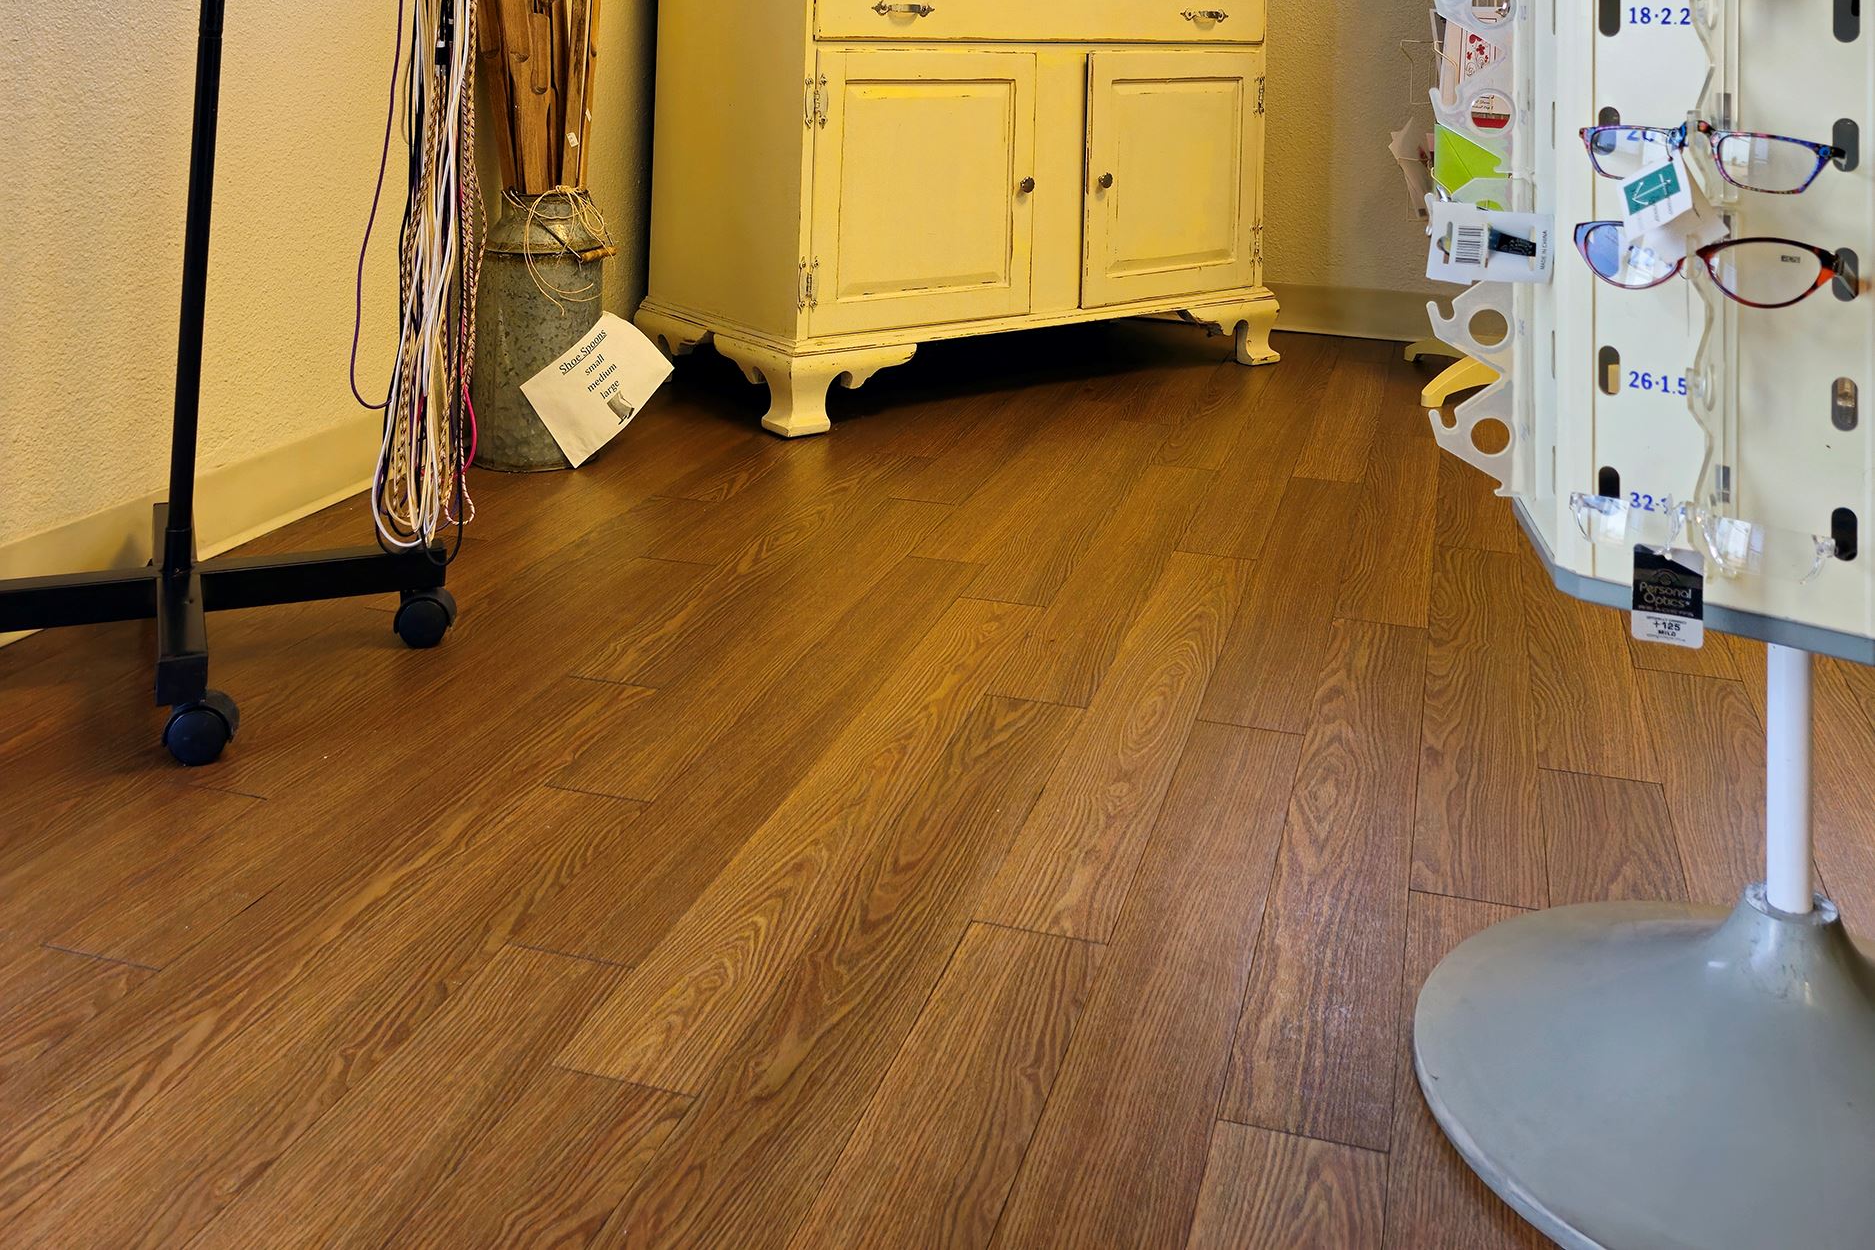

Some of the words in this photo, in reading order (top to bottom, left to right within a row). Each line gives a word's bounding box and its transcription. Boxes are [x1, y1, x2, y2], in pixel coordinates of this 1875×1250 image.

[558, 353, 581, 375] Shoe
[580, 329, 608, 357] Spoons
[584, 354, 605, 376] small
[587, 363, 617, 393] medium
[600, 380, 620, 401] large
[1640, 581, 1692, 599] Personal
